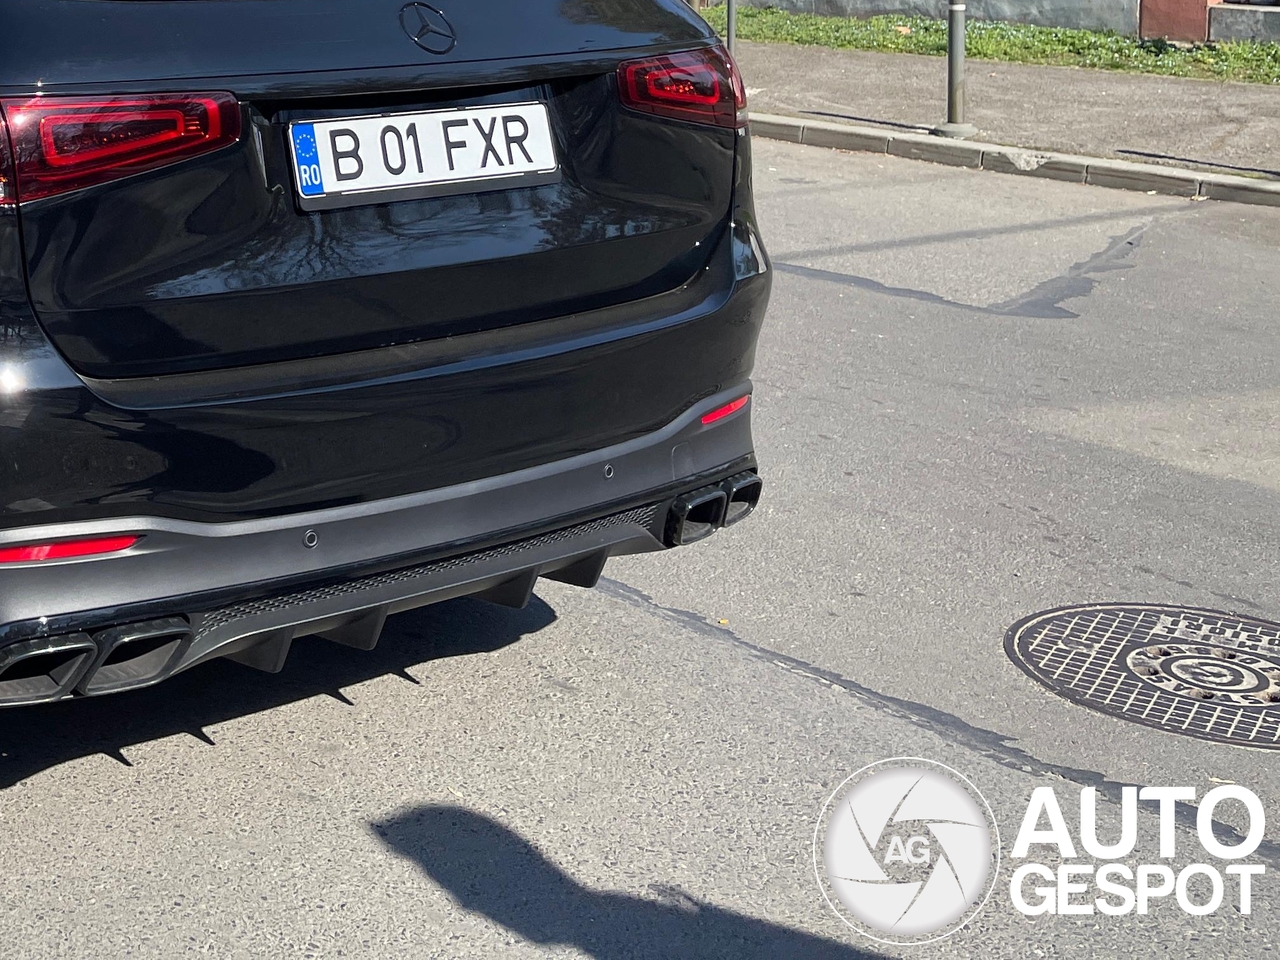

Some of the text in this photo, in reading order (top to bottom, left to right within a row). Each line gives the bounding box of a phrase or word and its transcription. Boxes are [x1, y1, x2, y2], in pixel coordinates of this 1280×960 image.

[329, 114, 534, 182] B 01 FXR
[299, 164, 322, 188] RO
